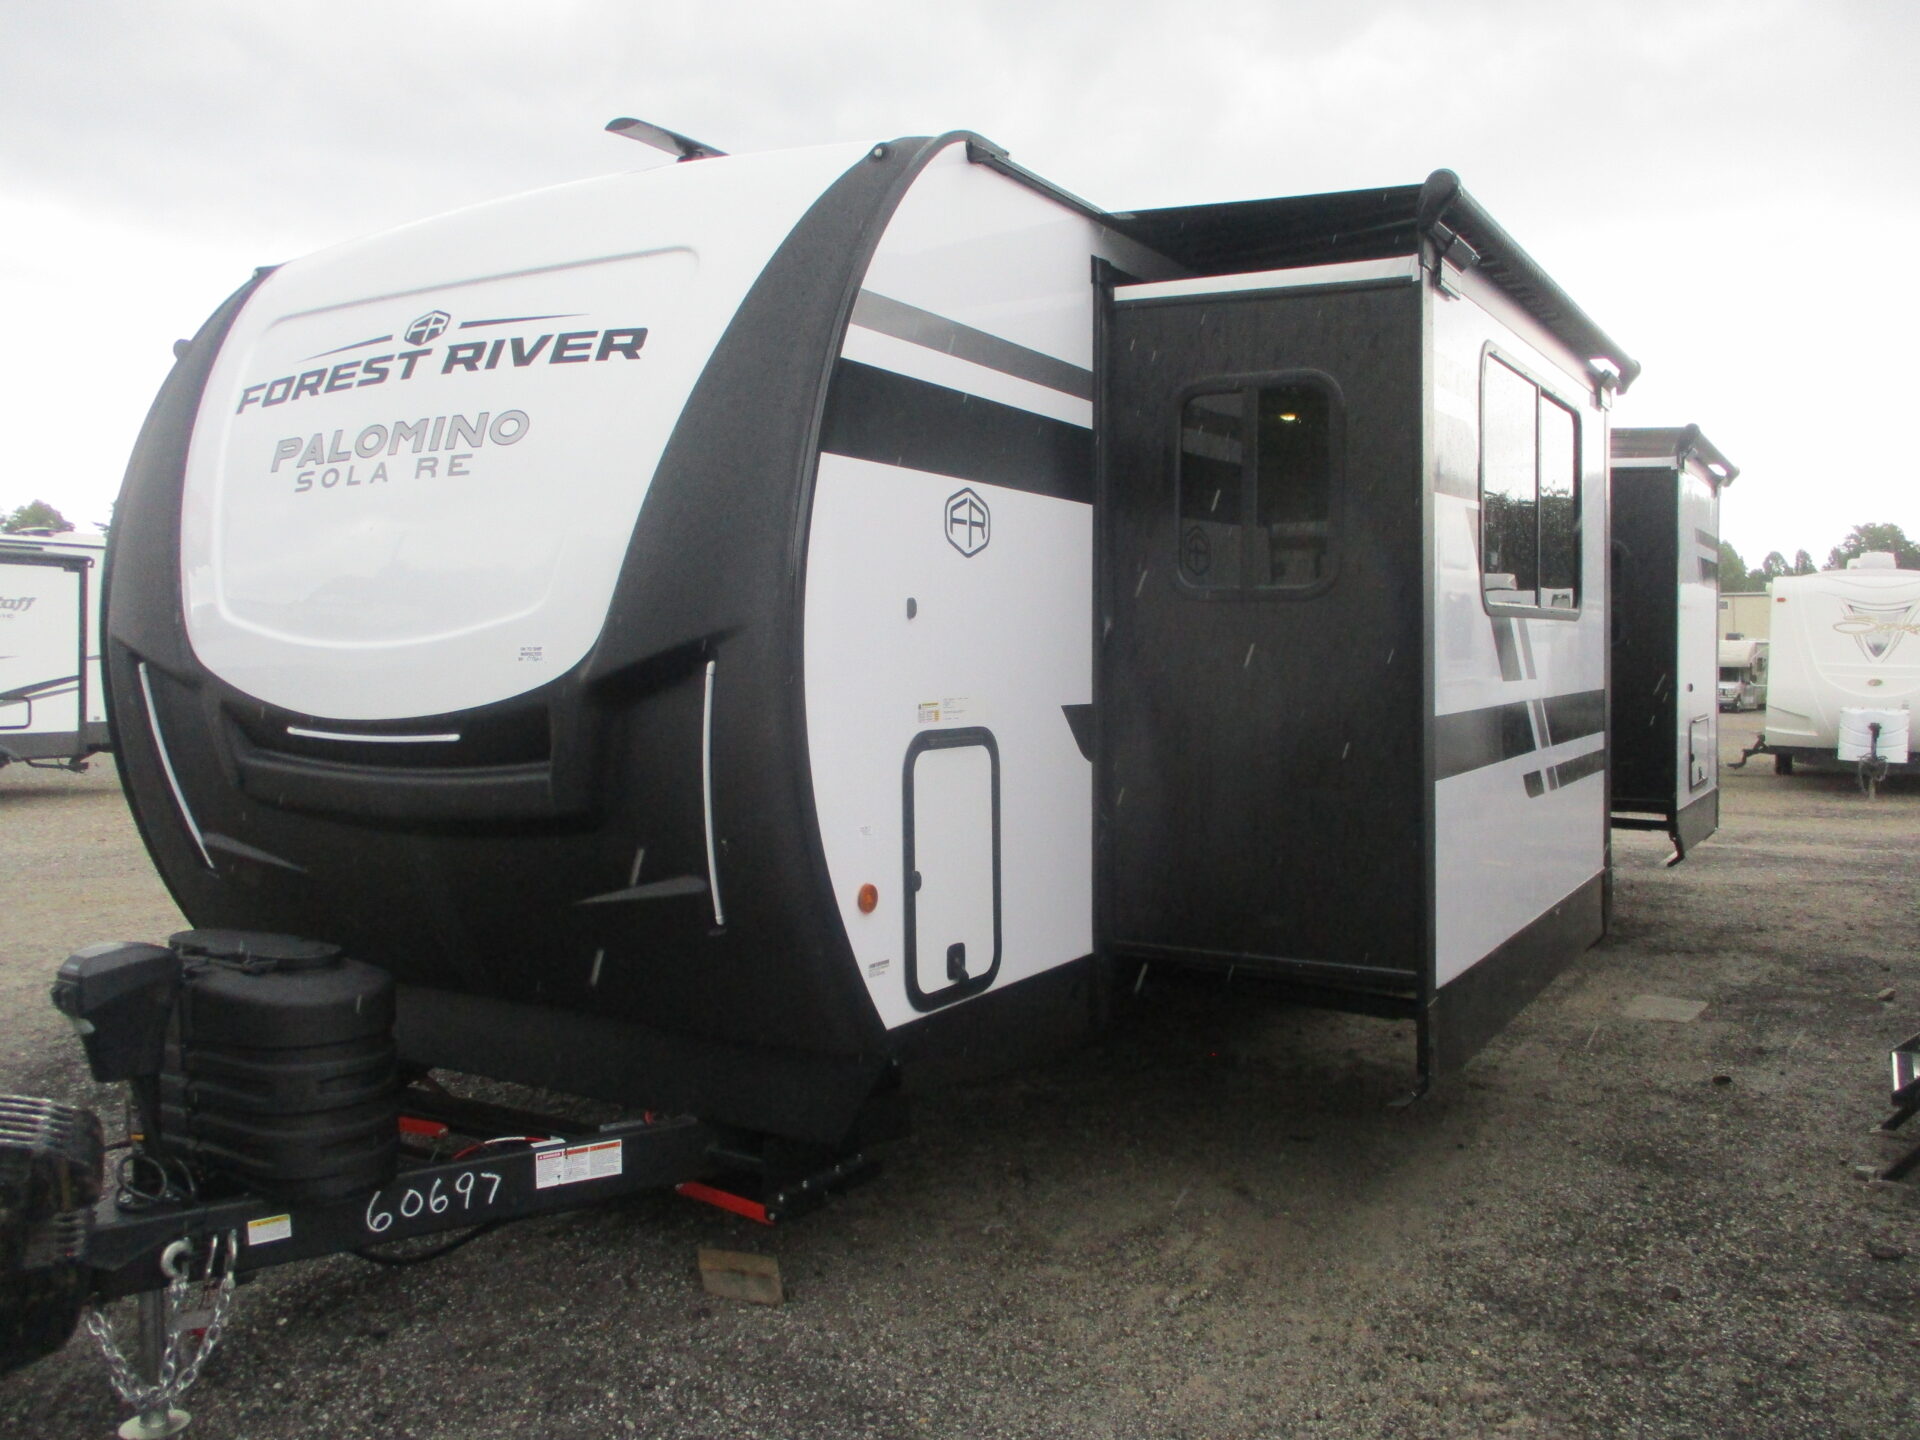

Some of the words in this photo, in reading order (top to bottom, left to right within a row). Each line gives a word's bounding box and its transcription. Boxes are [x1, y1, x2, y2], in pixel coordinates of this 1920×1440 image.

[236, 349, 432, 414] FOREST
[441, 327, 648, 374] RIVER
[270, 409, 530, 474] PALOMINO
[366, 1172, 501, 1232] 60697
